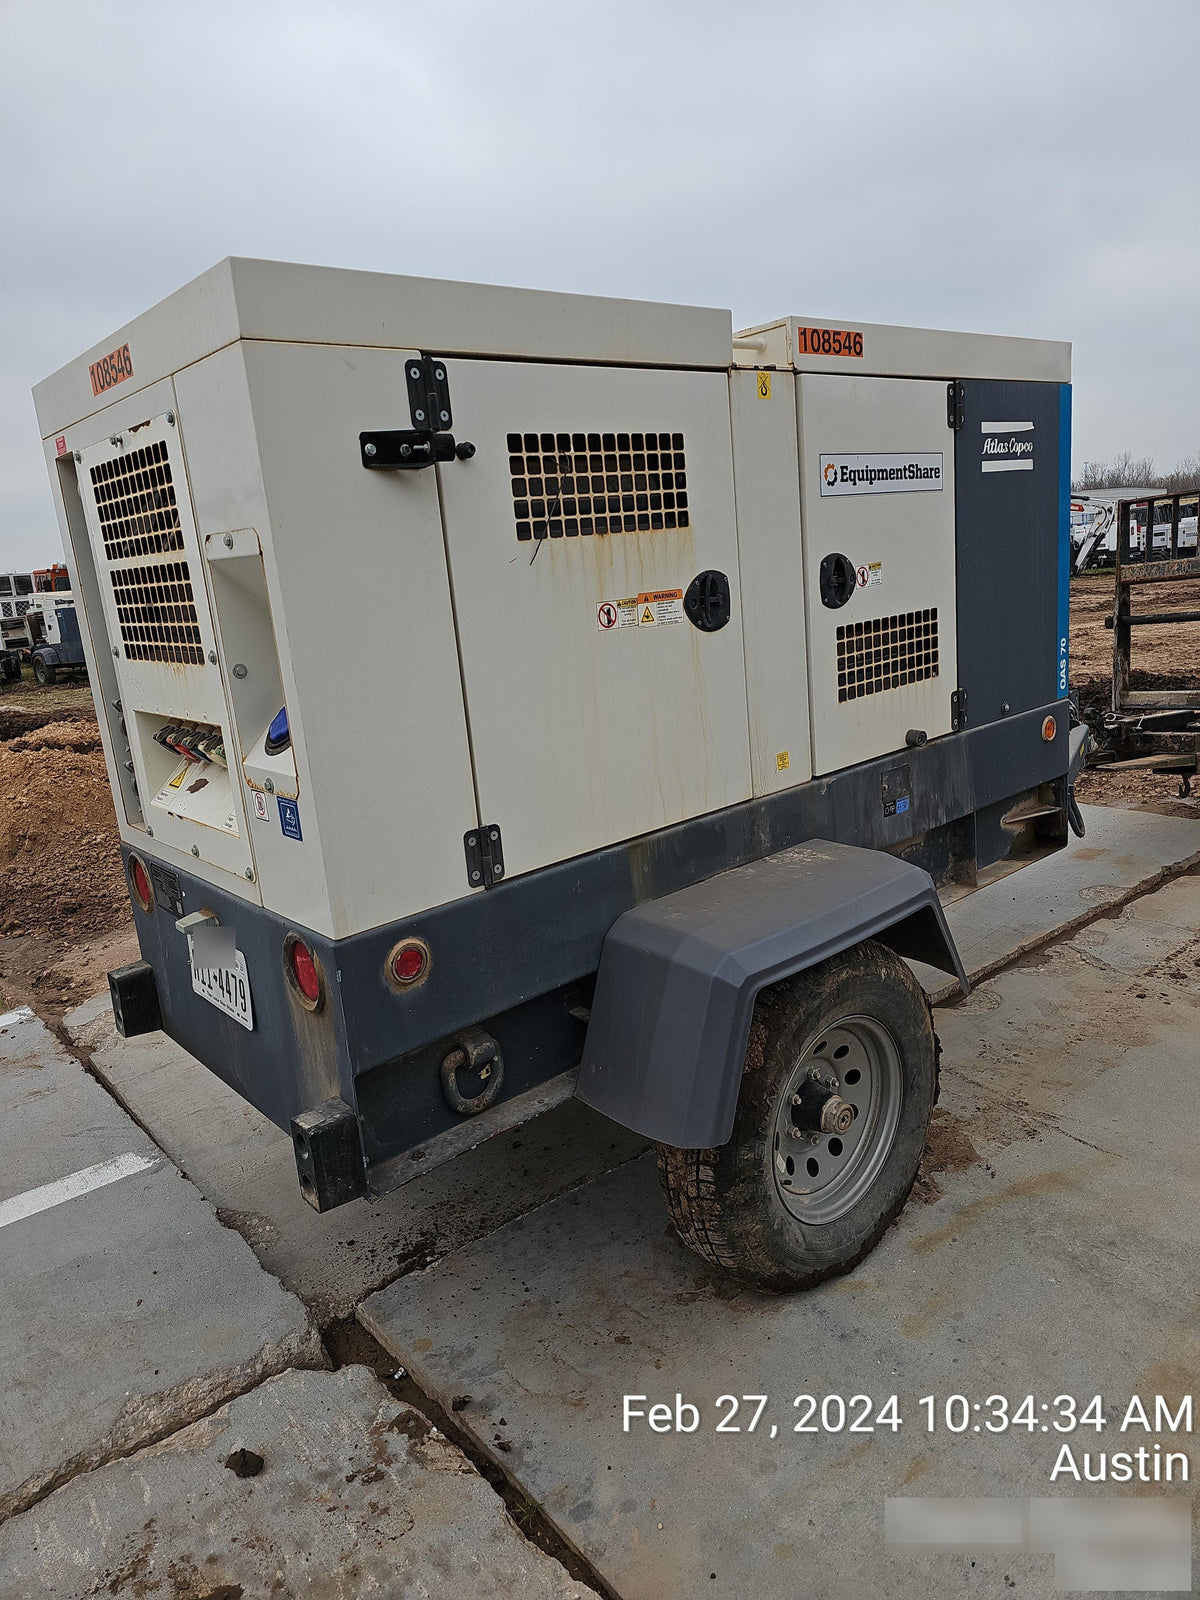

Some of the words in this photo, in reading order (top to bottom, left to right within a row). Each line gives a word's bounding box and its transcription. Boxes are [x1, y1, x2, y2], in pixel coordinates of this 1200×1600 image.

[800, 327, 864, 357] 108546
[90, 345, 132, 392] 108546
[981, 438, 1009, 454] Atlas
[1009, 437, 1034, 456] Copco
[840, 463, 941, 486] EquipmentShare
[653, 592, 678, 600] WARNING
[1060, 637, 1067, 656] 70
